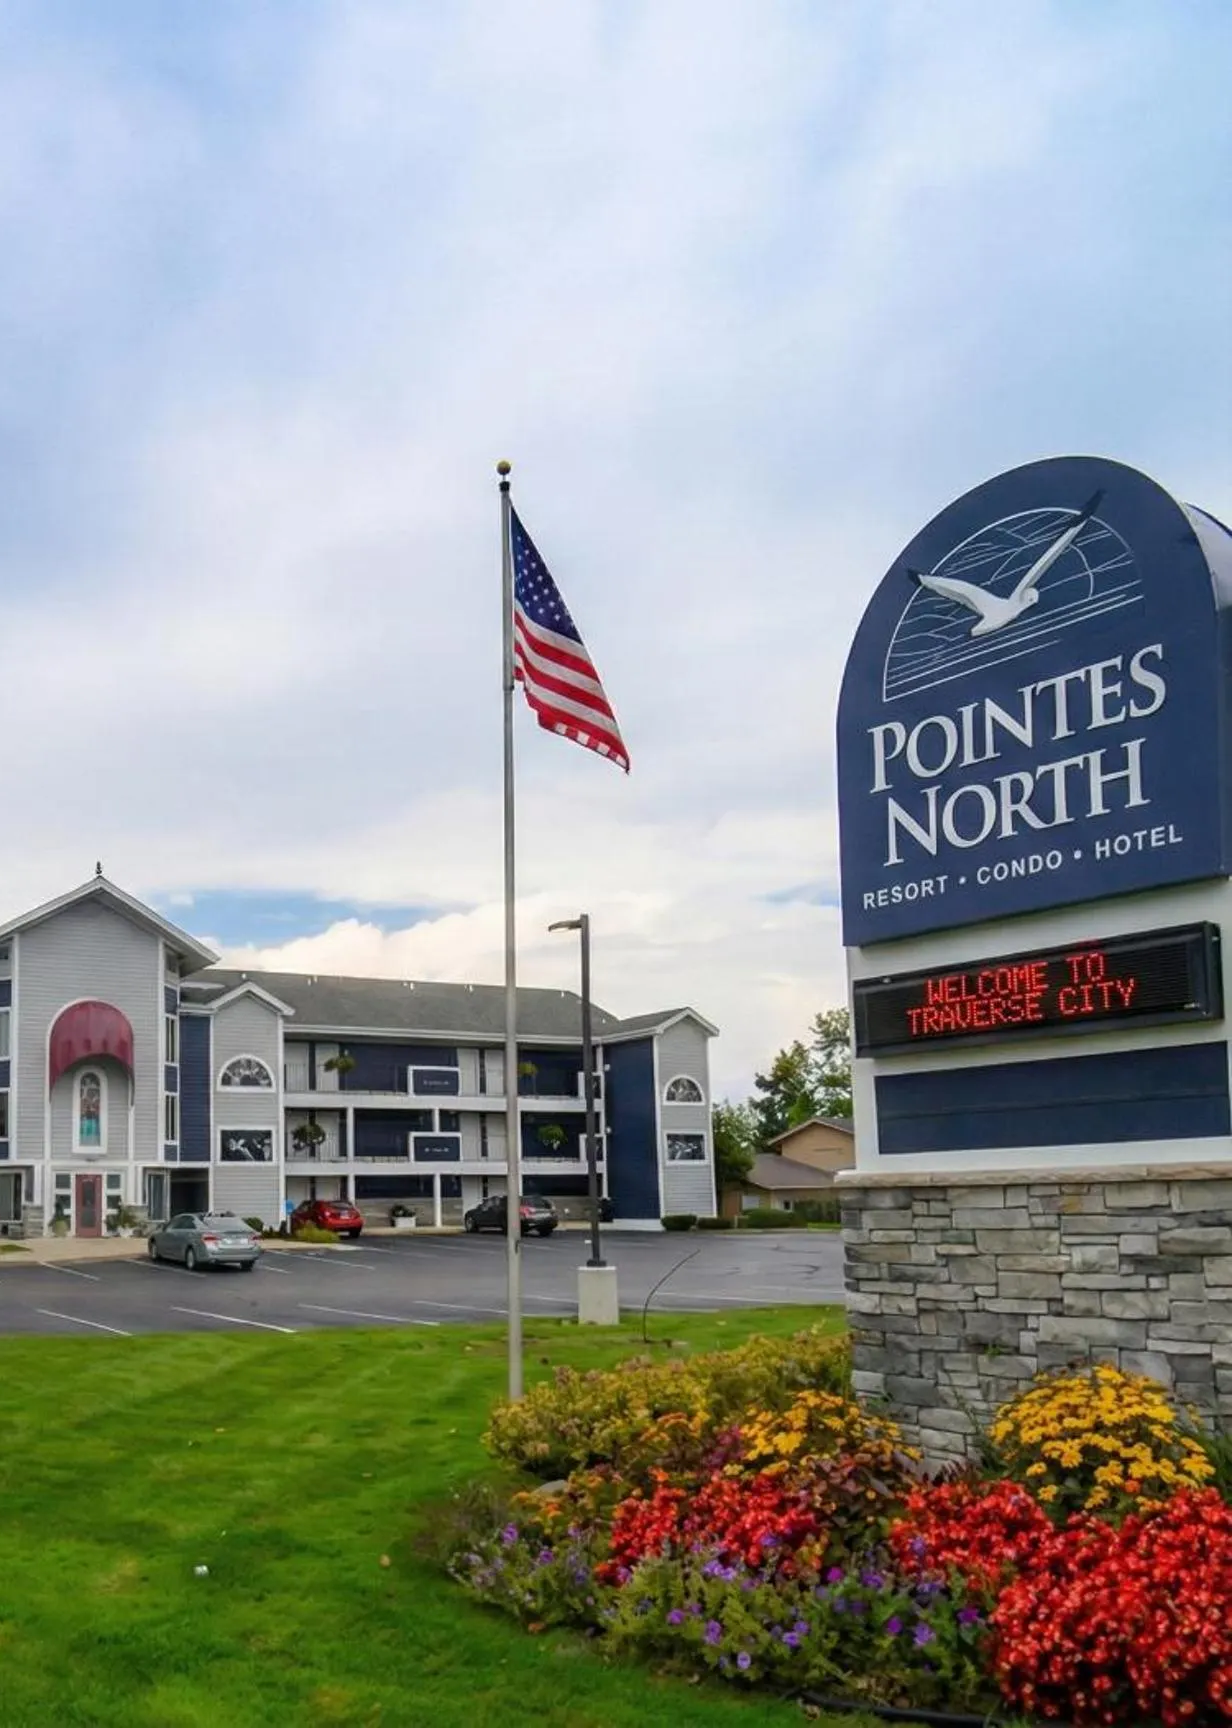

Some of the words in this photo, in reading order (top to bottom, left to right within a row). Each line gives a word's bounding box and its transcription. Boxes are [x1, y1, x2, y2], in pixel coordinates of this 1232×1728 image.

[867, 643, 1167, 793] POINTES
[883, 738, 1151, 867] NORTH
[863, 874, 949, 911] RESORT
[976, 850, 1064, 886] CONDO
[1094, 823, 1184, 861] HOTEL
[906, 993, 1043, 1036] TRAVERSE
[1059, 978, 1137, 1016] CITY
[925, 961, 1049, 1004] WELCOME
[1066, 953, 1106, 983] TO
